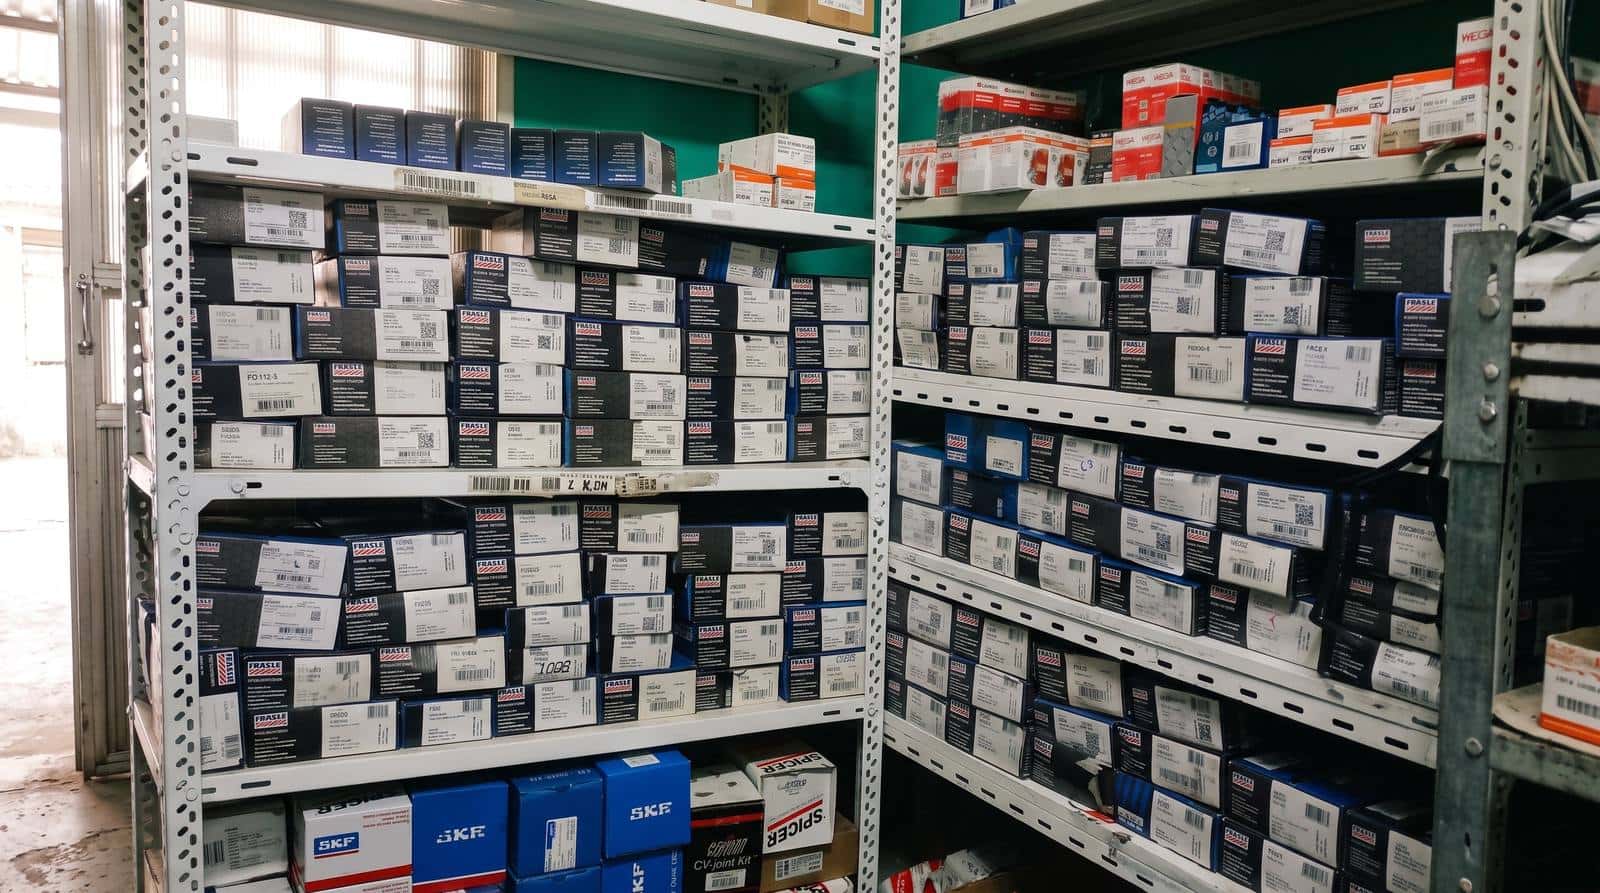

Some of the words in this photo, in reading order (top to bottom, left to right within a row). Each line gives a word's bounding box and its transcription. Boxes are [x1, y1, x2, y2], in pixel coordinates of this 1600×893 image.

[475, 255, 503, 264] FRASLE
[1120, 277, 1142, 285] FRASLE
[1406, 299, 1436, 307] FRASLE
[462, 310, 489, 318] FRASLE
[1256, 338, 1286, 347] FRASLE
[461, 366, 489, 374] FRASLE
[460, 422, 489, 430] FRASLE
[476, 559, 506, 568] FRASLE
[699, 626, 724, 634] FRASLE
[380, 647, 411, 655] FRASLE
[248, 662, 281, 670] FRASLE
[605, 679, 632, 688] FRASLE
[499, 687, 524, 696] FRASLE
[255, 713, 288, 722] FRASLE
[762, 752, 823, 774] SPICER
[629, 802, 673, 821] SKF
[767, 808, 824, 848] SPICER
[436, 825, 486, 844] SKF
[318, 836, 355, 851] SKF
[693, 858, 735, 872] CV-joint
[738, 855, 752, 866] Kit
[632, 862, 645, 893] KF
